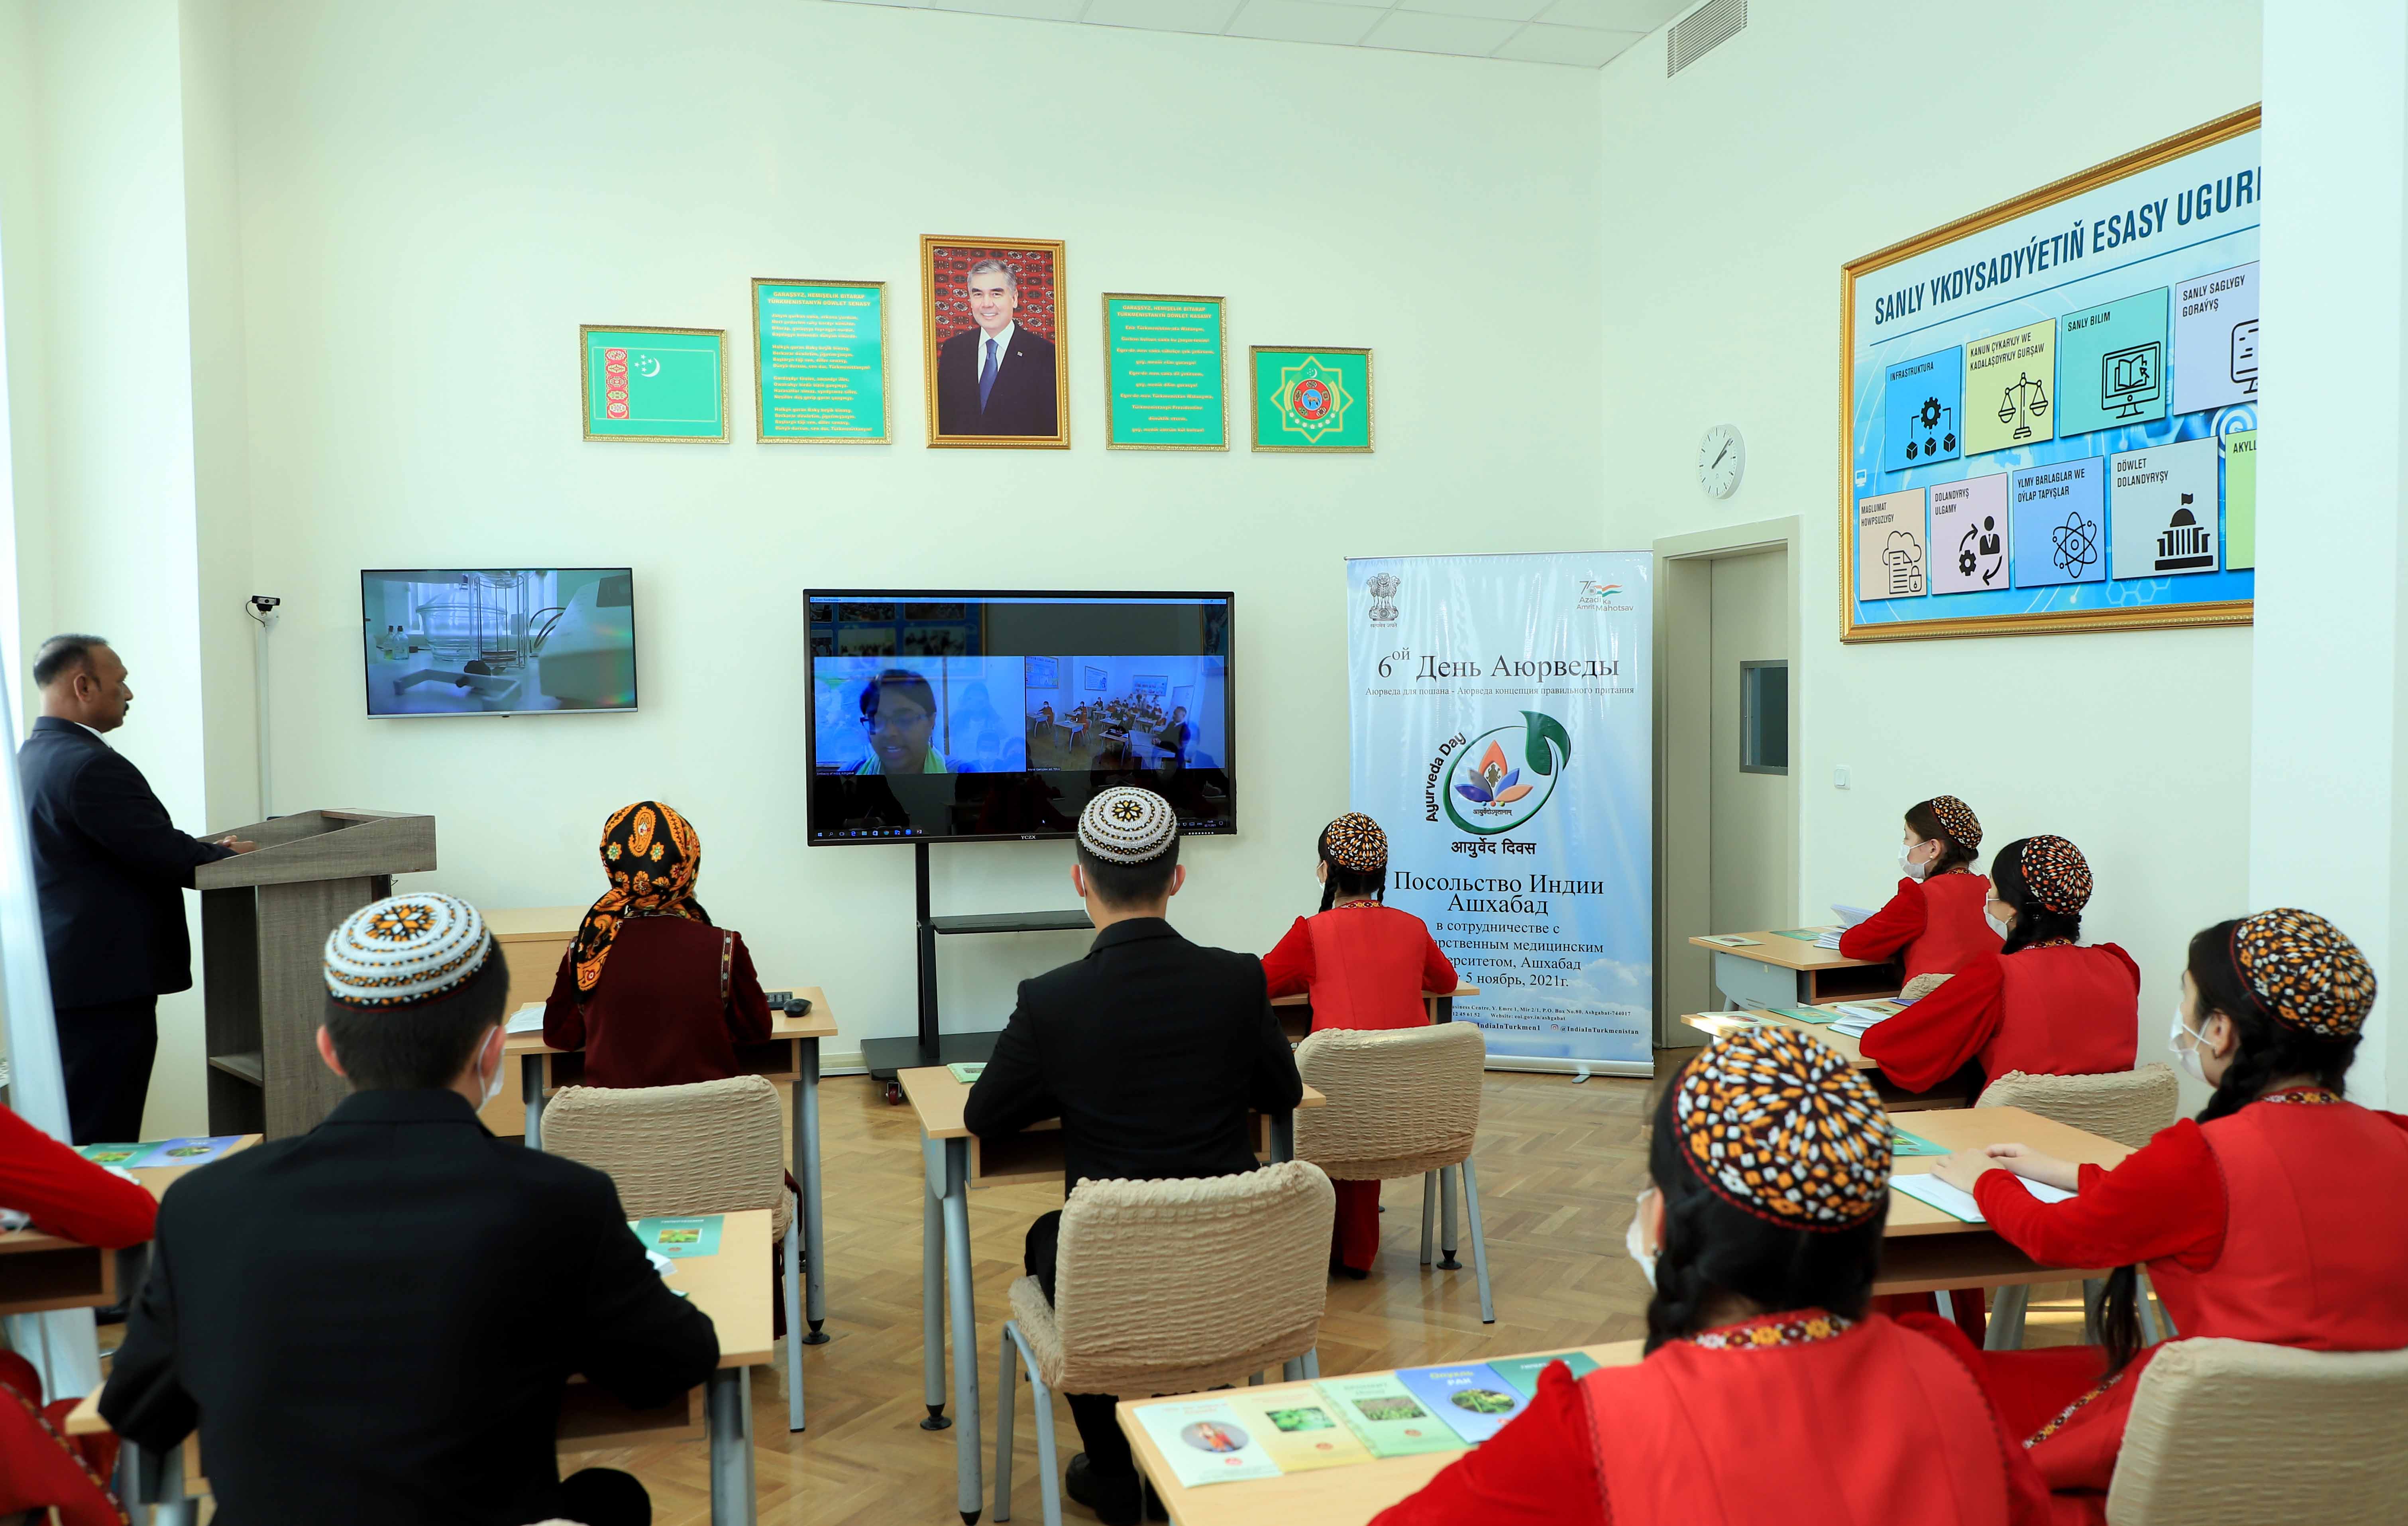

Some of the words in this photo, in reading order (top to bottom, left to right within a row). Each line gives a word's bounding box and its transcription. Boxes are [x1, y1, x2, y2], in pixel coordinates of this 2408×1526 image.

[1875, 283, 1925, 325] SANLY
[1931, 219, 2084, 306] YKDYSADYÝETIŇ
[2093, 198, 2168, 254] ESASY
[2183, 285, 2207, 301] SANLY
[2210, 274, 2245, 294] SAGLYGY
[2182, 298, 2219, 317] GORAÝYŞ
[2068, 317, 2088, 332] SANLY
[2090, 312, 2110, 326] BILIM
[1970, 343, 1990, 358] KANUN
[1992, 335, 2020, 354] ÇYKARYJY
[2021, 332, 2031, 343] WE
[1970, 353, 2015, 371] KADALAŞDYRYJY
[2017, 343, 2045, 359] GURŞAW
[1890, 362, 1934, 382] INFRASTRUKTURA
[2117, 458, 2147, 472] DÖWLET
[2017, 476, 2033, 488] YLMY
[2035, 471, 2072, 485] BARLAGLAR
[2075, 469, 2085, 479] WE
[2117, 470, 2168, 488] DOLANDYRYŞY
[1935, 488, 1969, 502] DOLANDYRYŞ
[2017, 490, 2036, 503] OÝLAP
[2038, 486, 2069, 500] TAPYŞLAR
[1861, 502, 1887, 514] MAGLUMAT
[1935, 504, 1956, 515] ULGAMY
[1861, 514, 1894, 527] HOWPSUZLYGY
[1416, 656, 1481, 682] День
[1490, 654, 1620, 683] Аюрведы
[1366, 687, 1400, 697] Аюрведа
[1457, 687, 1493, 697] Аюрведа
[1541, 687, 1592, 696] правильного
[1426, 757, 1444, 822] Ayurveda
[1438, 732, 1466, 756] Day
[1451, 837, 1497, 858] आयुर्वेद
[1501, 838, 1536, 854] दिवस
[1394, 871, 1522, 892] Посольство
[1529, 874, 1604, 896] Индии
[1447, 893, 1548, 916] Ашхабад
[1448, 922, 1549, 934] сотрудничестве
[1434, 939, 1508, 950] рственным
[1513, 942, 1603, 953] медицинским
[1448, 957, 1516, 969] ерситетом,
[1521, 957, 1581, 970] Ашхабад
[1465, 973, 1472, 983] 5
[1477, 973, 1525, 987] ноябрь,
[1530, 974, 1569, 987] 2021г.
[1561, 1026, 1639, 1034] @IndiaInTurkmenistan
